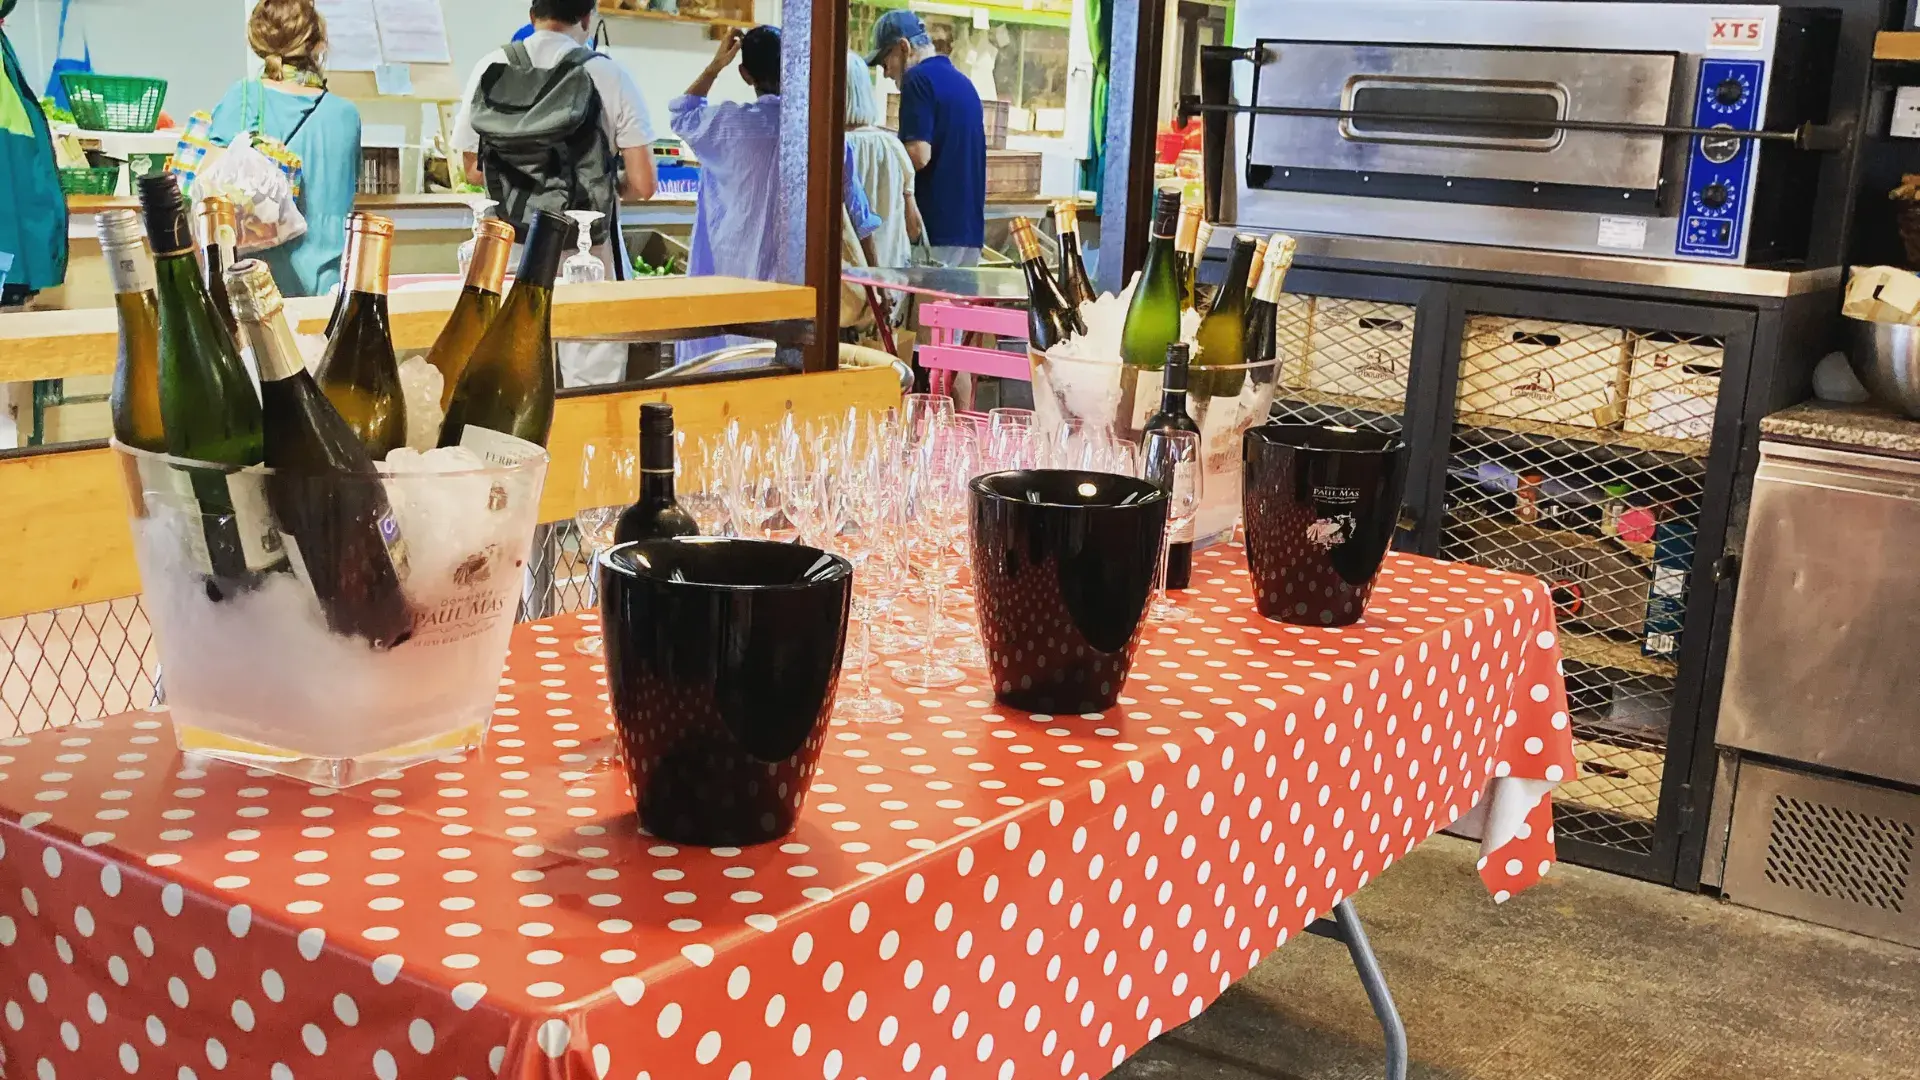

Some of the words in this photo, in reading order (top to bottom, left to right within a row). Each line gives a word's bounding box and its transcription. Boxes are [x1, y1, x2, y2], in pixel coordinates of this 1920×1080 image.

[1713, 22, 1760, 39] XTS
[1312, 488, 1336, 497] PAUL
[1339, 489, 1360, 497] MAS
[413, 607, 462, 629] PAUL
[468, 597, 506, 618] MAS
